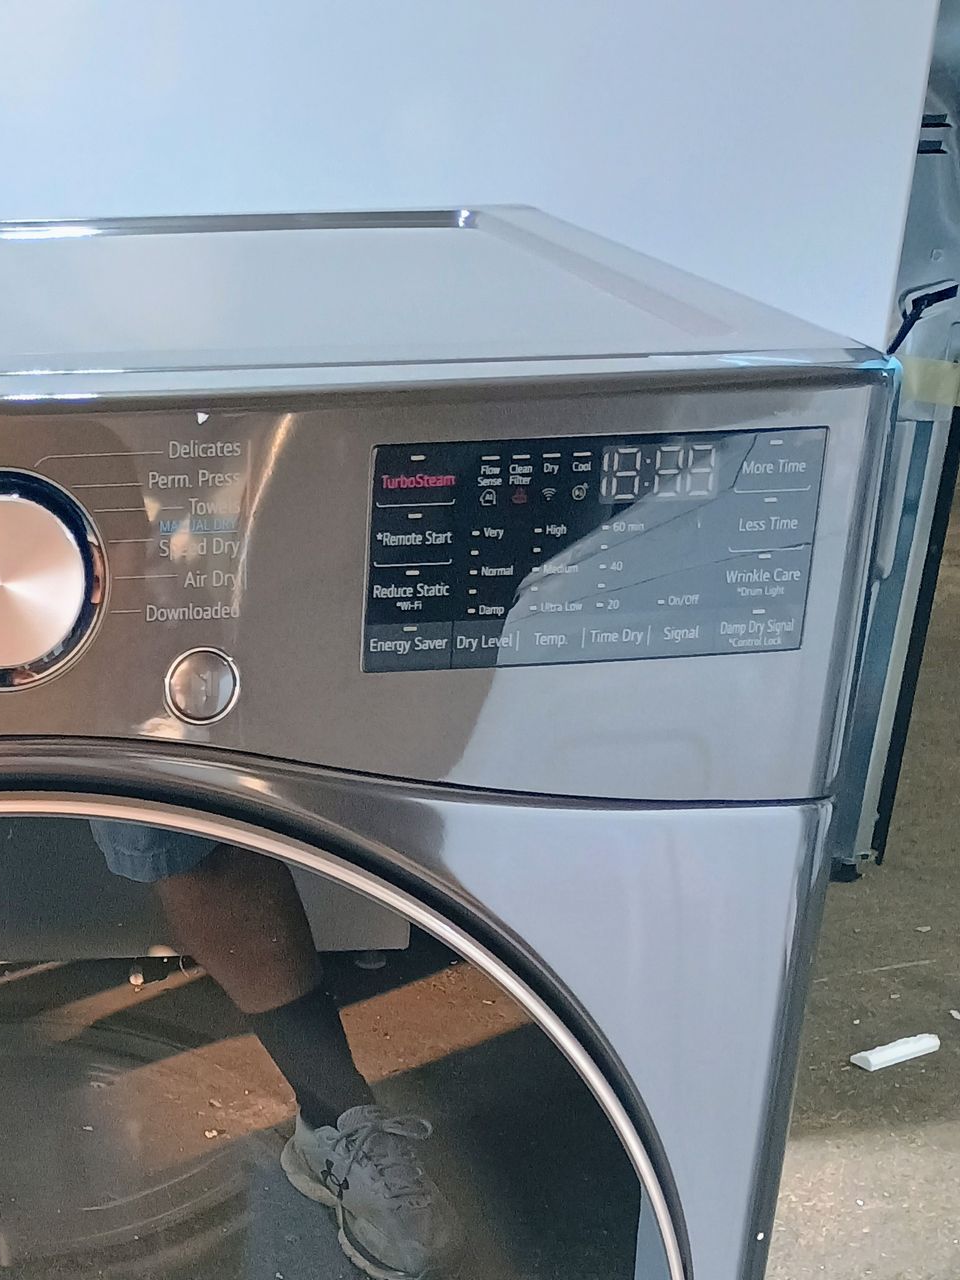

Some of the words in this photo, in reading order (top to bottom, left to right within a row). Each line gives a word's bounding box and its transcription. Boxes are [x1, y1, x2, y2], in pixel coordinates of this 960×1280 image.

[169, 439, 241, 458] Delicates
[481, 465, 500, 475] Flow
[509, 464, 533, 474] Clean
[543, 463, 559, 475] Dry
[572, 461, 592, 472] Cool
[742, 461, 774, 474] More
[778, 459, 807, 473] Time
[148, 471, 193, 489] Perm.
[198, 469, 241, 487] Press
[382, 474, 456, 489] TurboSteam
[478, 477, 502, 487] Sense
[509, 475, 532, 485] Filter
[159, 517, 209, 532] MAUAL
[213, 517, 237, 531] DRY
[546, 525, 567, 538] High
[612, 521, 626, 532] 60
[739, 518, 766, 532] Less
[770, 516, 799, 530] Time
[425, 530, 453, 545] Start
[483, 527, 504, 539] Very
[213, 537, 241, 558] Dry
[481, 565, 514, 576] Normal
[543, 563, 579, 574] Medium
[610, 560, 623, 571] 40
[183, 570, 207, 588] Air
[213, 570, 239, 592] Dry
[726, 569, 770, 583] Wrinkle
[773, 568, 801, 581] Care
[373, 584, 413, 598] Reduce
[416, 582, 450, 597] Static
[765, 585, 785, 597] Light
[540, 602, 563, 612] Ultra
[565, 601, 583, 611] Low
[607, 599, 620, 610] 20
[668, 594, 700, 606] On/Off
[146, 602, 240, 622] Downloaded
[478, 605, 505, 616] Damp
[663, 625, 700, 643] Signal
[720, 621, 746, 635] Damp
[748, 620, 765, 635] Dry
[767, 618, 795, 635] Signal
[456, 635, 479, 652] Dry
[481, 633, 513, 649] Level
[534, 632, 569, 648] Temp.
[590, 629, 619, 643] Time
[622, 628, 644, 645] Dry
[369, 638, 412, 655] Energy
[414, 636, 449, 651] Saver
